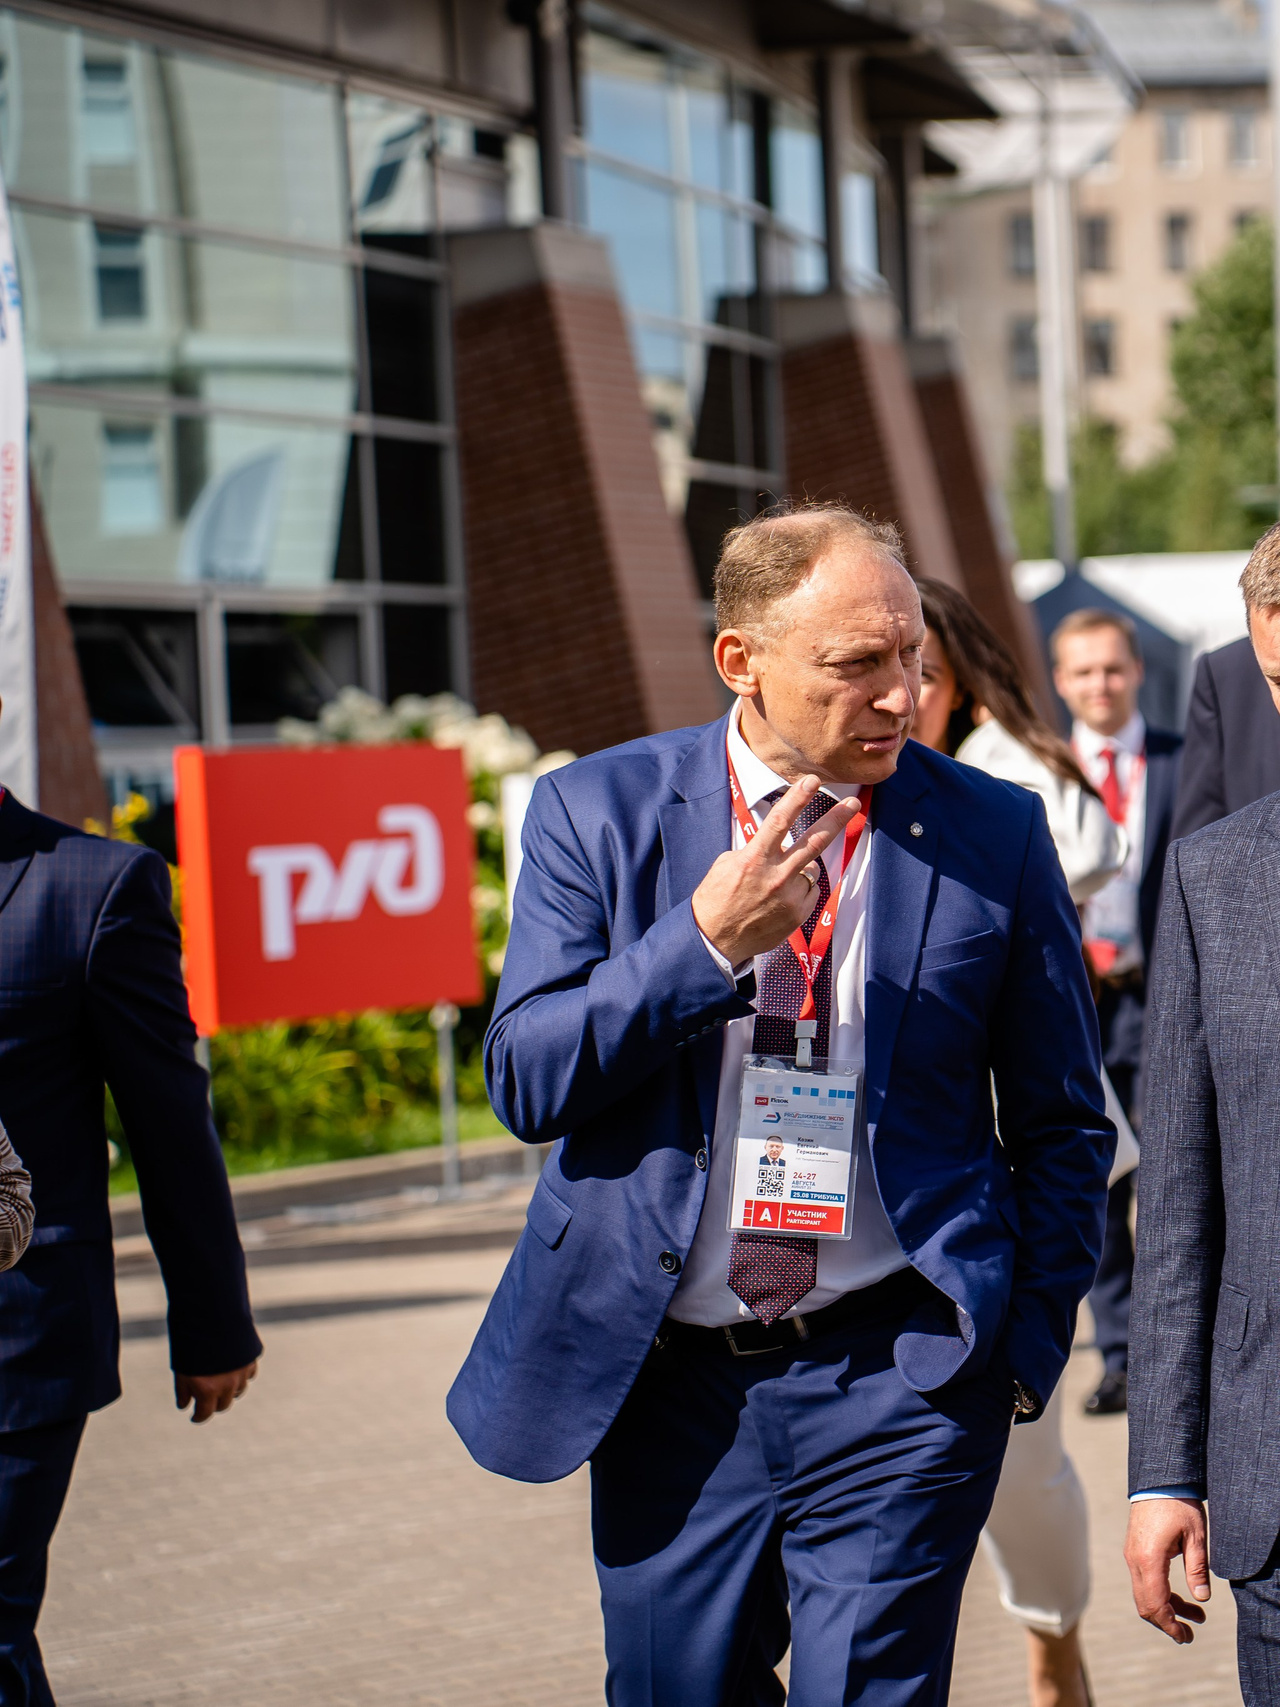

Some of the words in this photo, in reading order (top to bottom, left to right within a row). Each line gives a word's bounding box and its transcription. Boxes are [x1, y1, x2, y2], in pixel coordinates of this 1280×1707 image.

[793, 1171, 817, 1180] 24-27
[792, 1191, 810, 1199] 25.08
[810, 1193, 839, 1201] ТРИБУНА
[787, 1209, 828, 1219] УЧАСТНИК
[786, 1218, 821, 1226] PARTICIPANT
